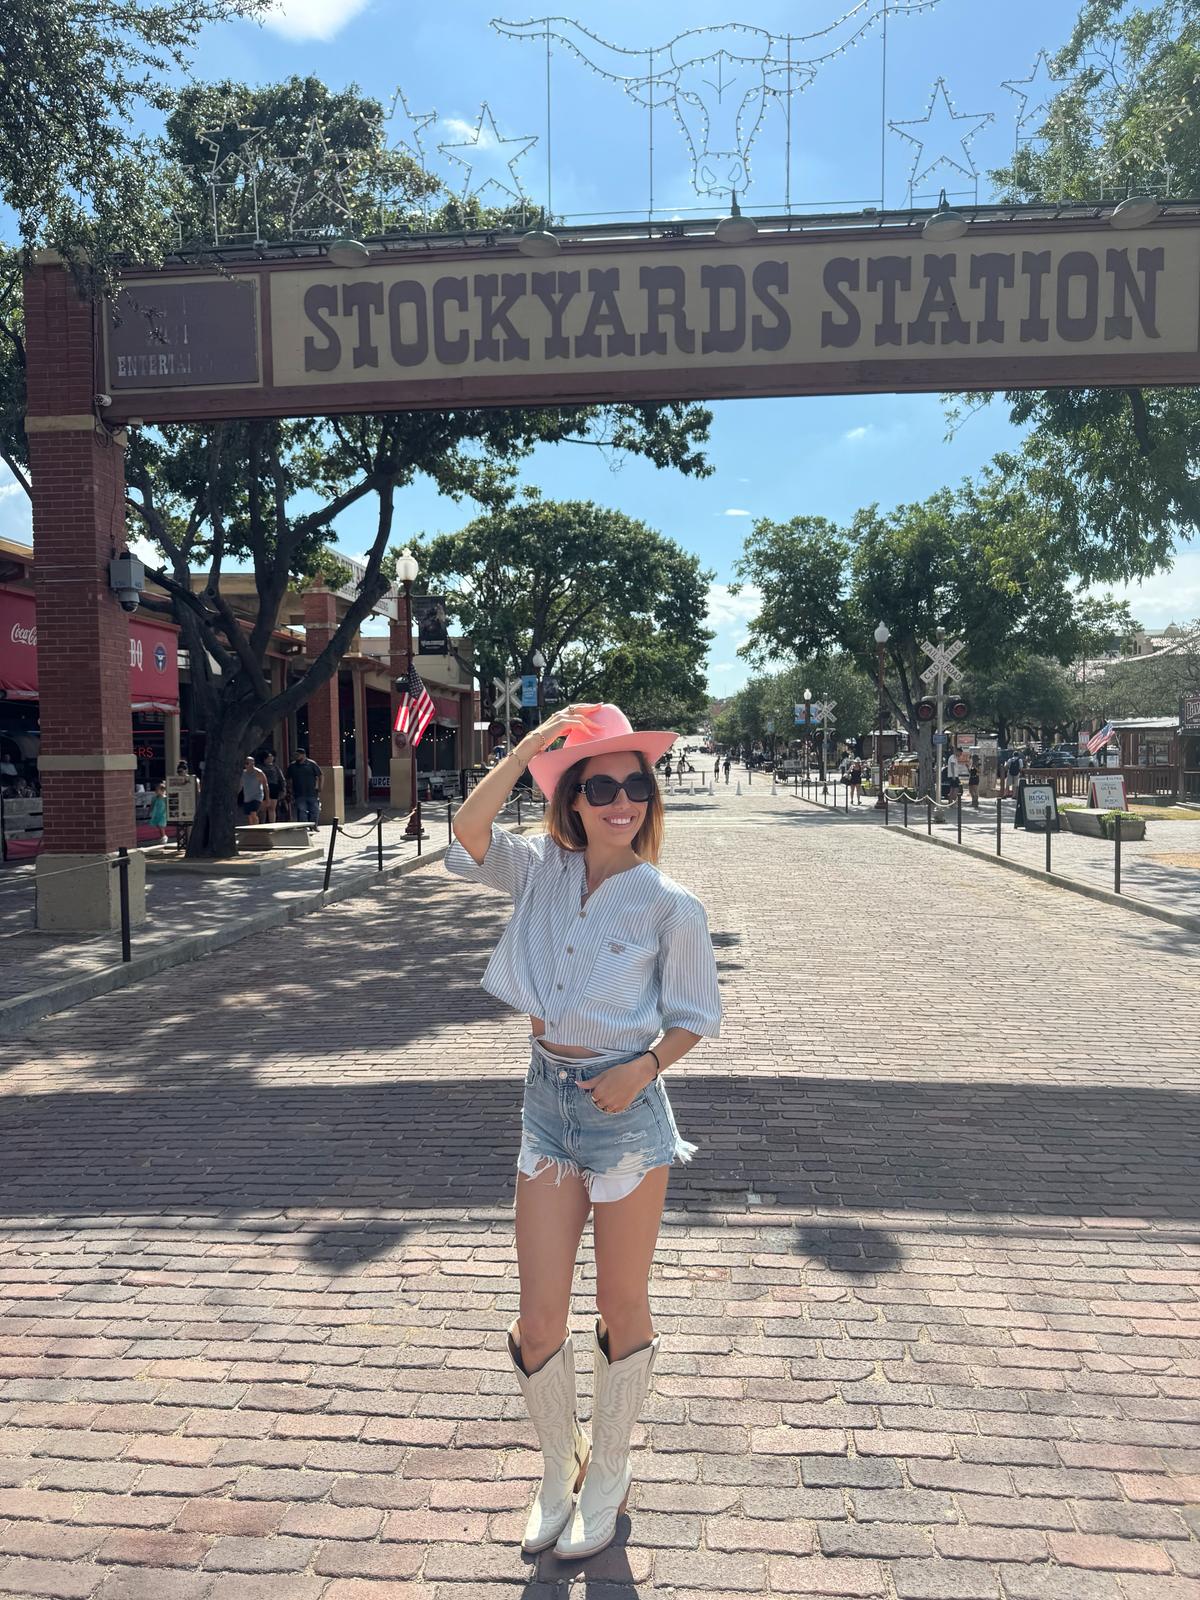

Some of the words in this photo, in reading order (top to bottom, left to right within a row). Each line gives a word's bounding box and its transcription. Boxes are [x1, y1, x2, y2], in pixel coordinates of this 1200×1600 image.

[303, 260, 792, 373] STOCKYARDS
[820, 246, 1165, 349] STATION
[128, 638, 144, 672] BQ
